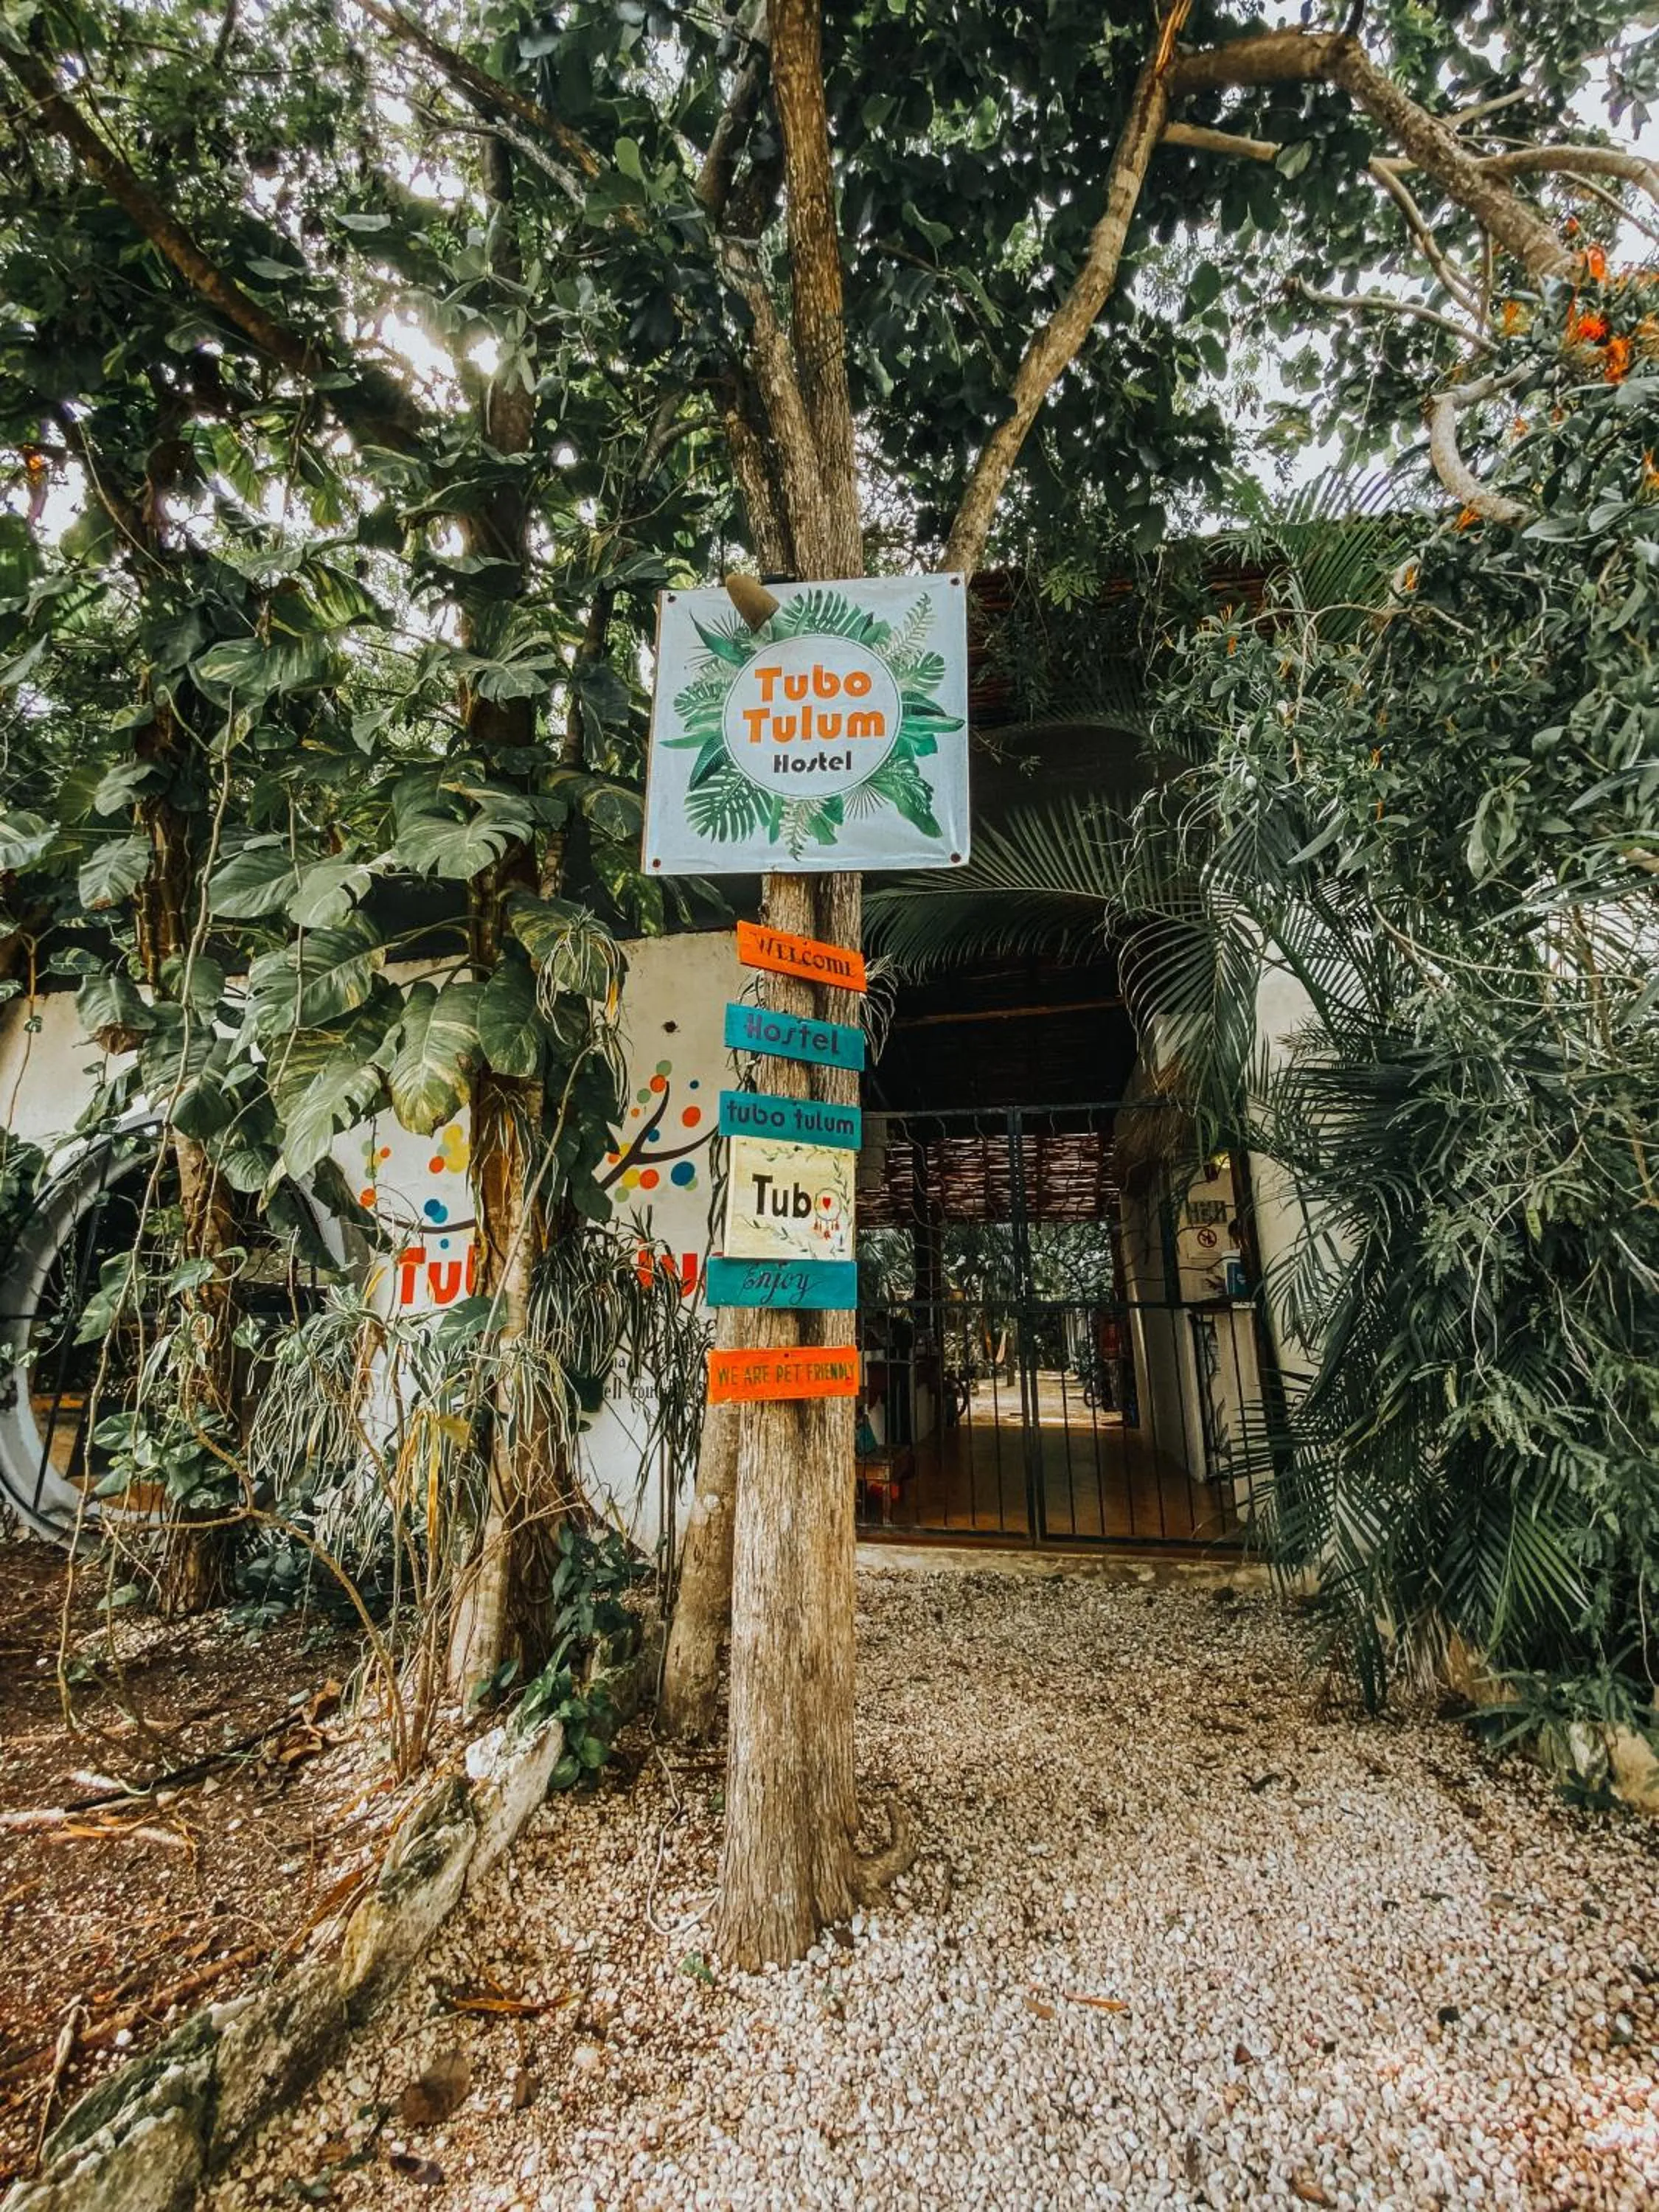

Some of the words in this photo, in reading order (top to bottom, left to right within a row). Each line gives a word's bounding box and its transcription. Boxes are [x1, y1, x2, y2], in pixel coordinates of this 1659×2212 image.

[754, 665, 872, 702] Tubo
[742, 706, 886, 743] Tulum
[773, 751, 852, 774] Hostel
[745, 1013, 839, 1055] Hostel
[727, 1099, 785, 1127] tubo
[794, 1108, 855, 1135] tulum
[742, 1265, 827, 1306] Enjoy
[718, 1366, 737, 1386] WE
[744, 1365, 769, 1384] ARE
[776, 1364, 801, 1382] PET
